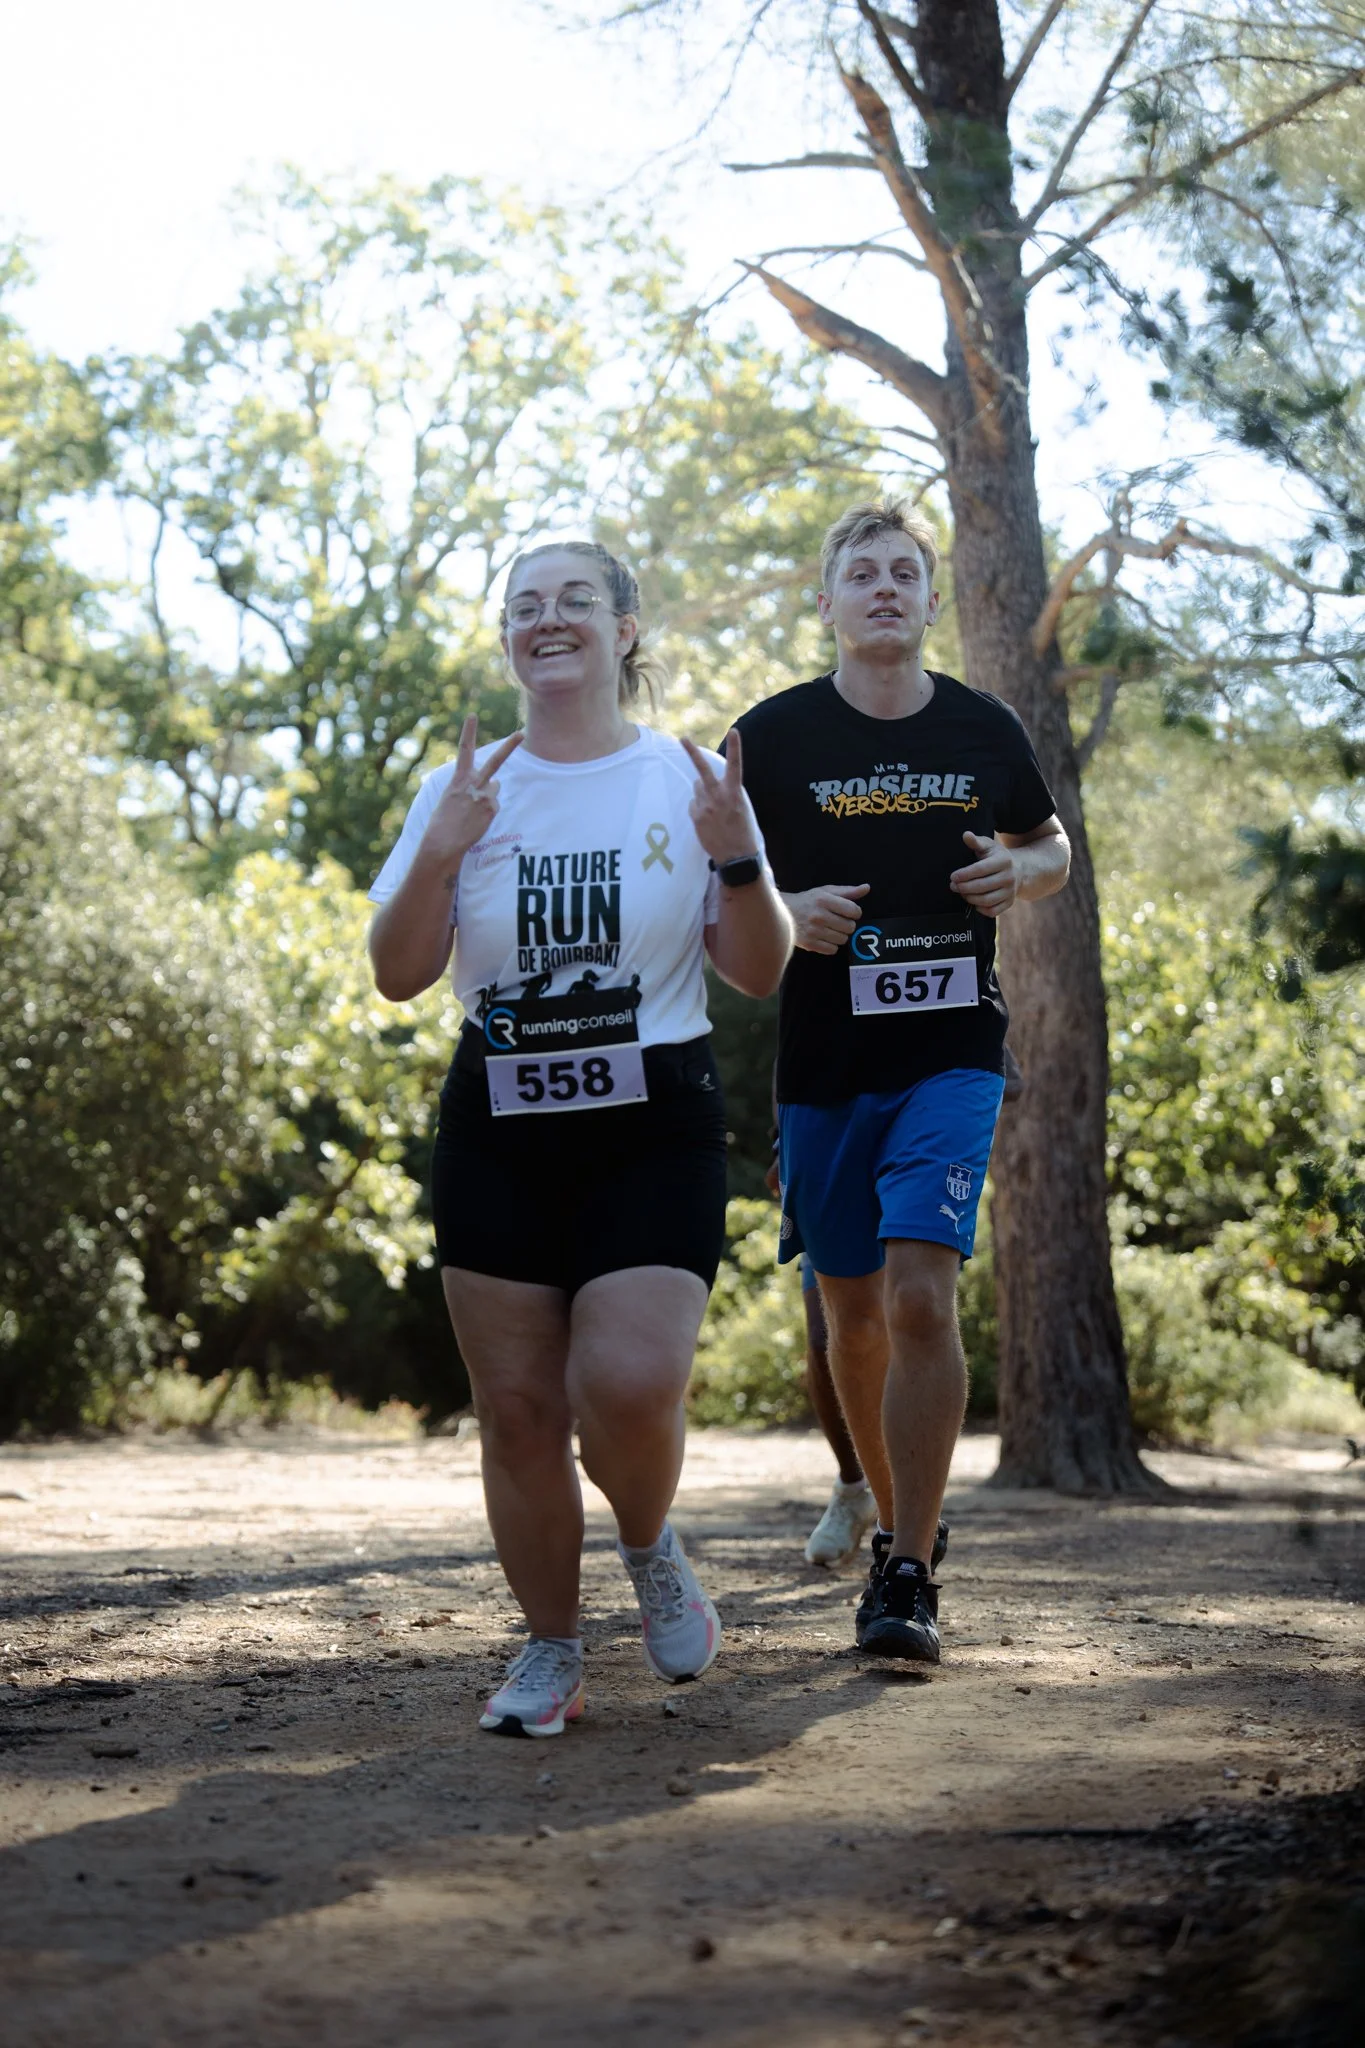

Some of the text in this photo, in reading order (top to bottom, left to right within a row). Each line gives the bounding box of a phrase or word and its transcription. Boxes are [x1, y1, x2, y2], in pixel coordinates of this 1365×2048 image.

[812, 774, 976, 805] BOISERIE
[518, 849, 621, 886] NATURE
[517, 884, 620, 947] RUN
[885, 930, 973, 948] runningconseil
[518, 943, 621, 973] DE BOURBAKI
[875, 967, 954, 1005] 657
[521, 1008, 633, 1035] runningconseil
[516, 1057, 615, 1103] 558
[900, 1562, 918, 1573] NIKE
